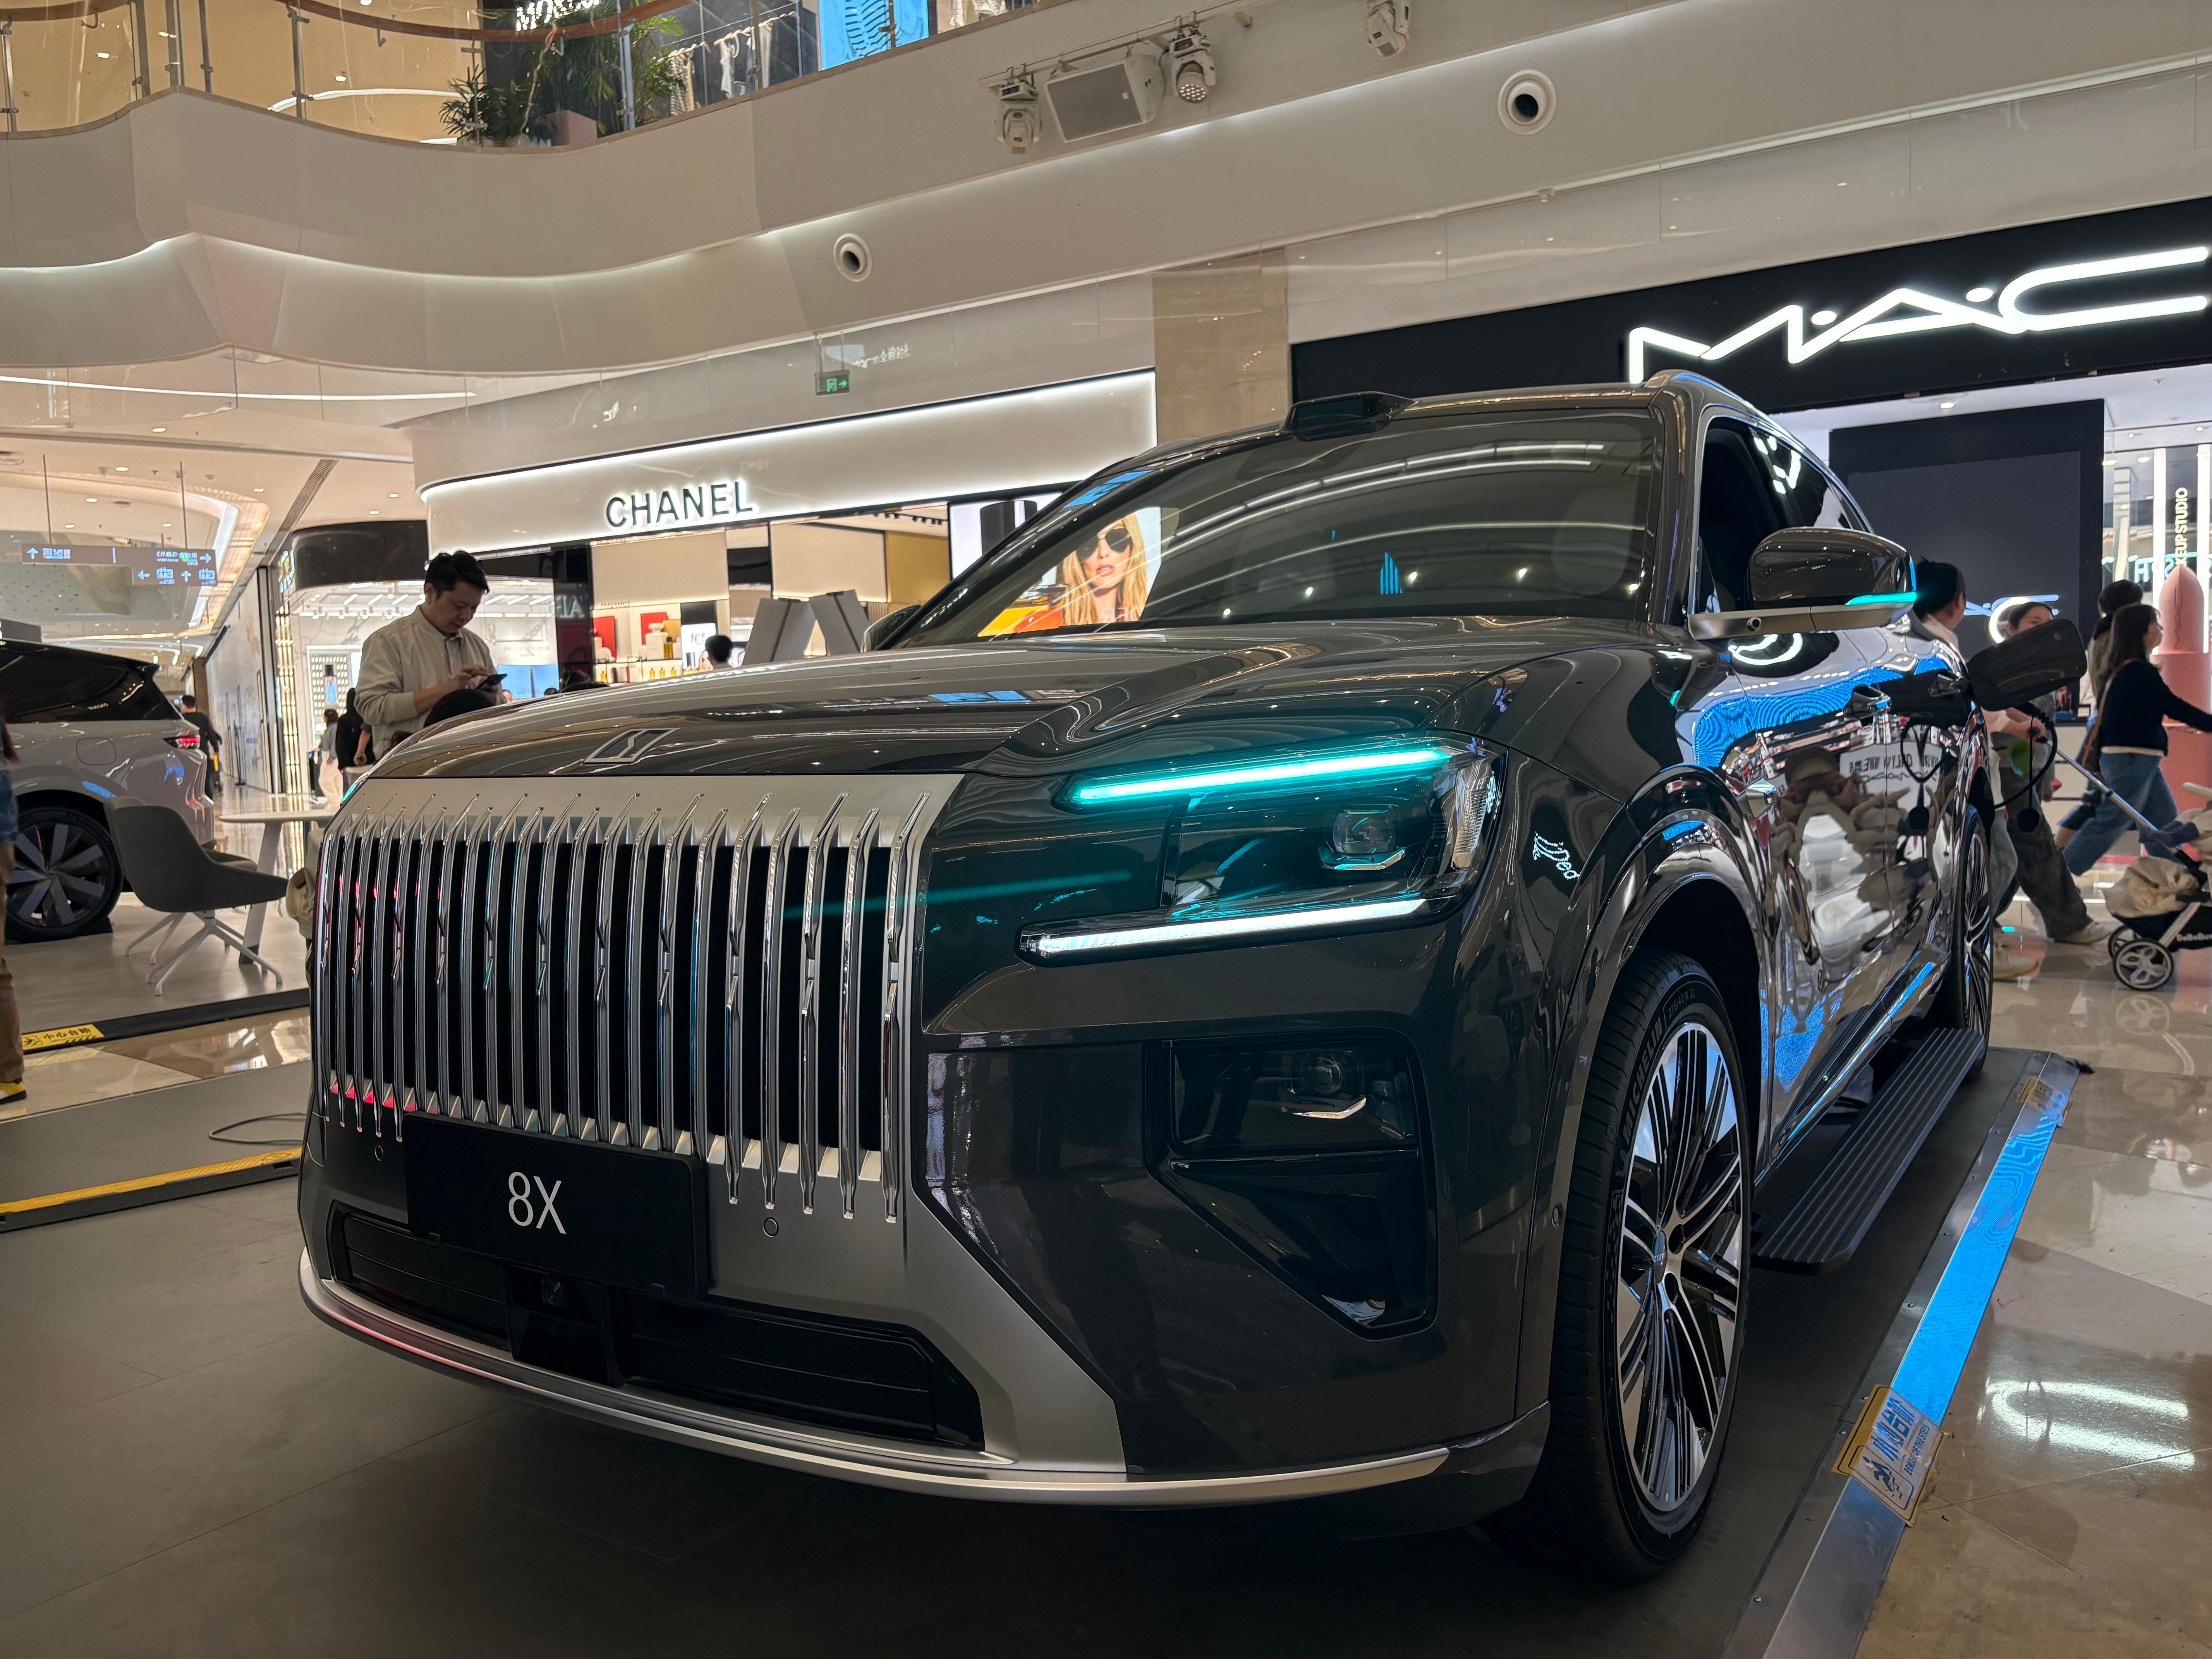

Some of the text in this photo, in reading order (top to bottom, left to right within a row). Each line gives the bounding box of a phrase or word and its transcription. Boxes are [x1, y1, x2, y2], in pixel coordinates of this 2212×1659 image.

[606, 481, 753, 527] CHANEL
[2175, 534, 2188, 567] KEUP
[1668, 993, 1685, 1018] 275/40
[1689, 988, 1695, 998] 22
[44, 1028, 91, 1039] 小心台阶
[1623, 1016, 1663, 1146] MICHELIN
[508, 1171, 567, 1235] 8X
[1871, 1397, 1915, 1463] 小心台阶
